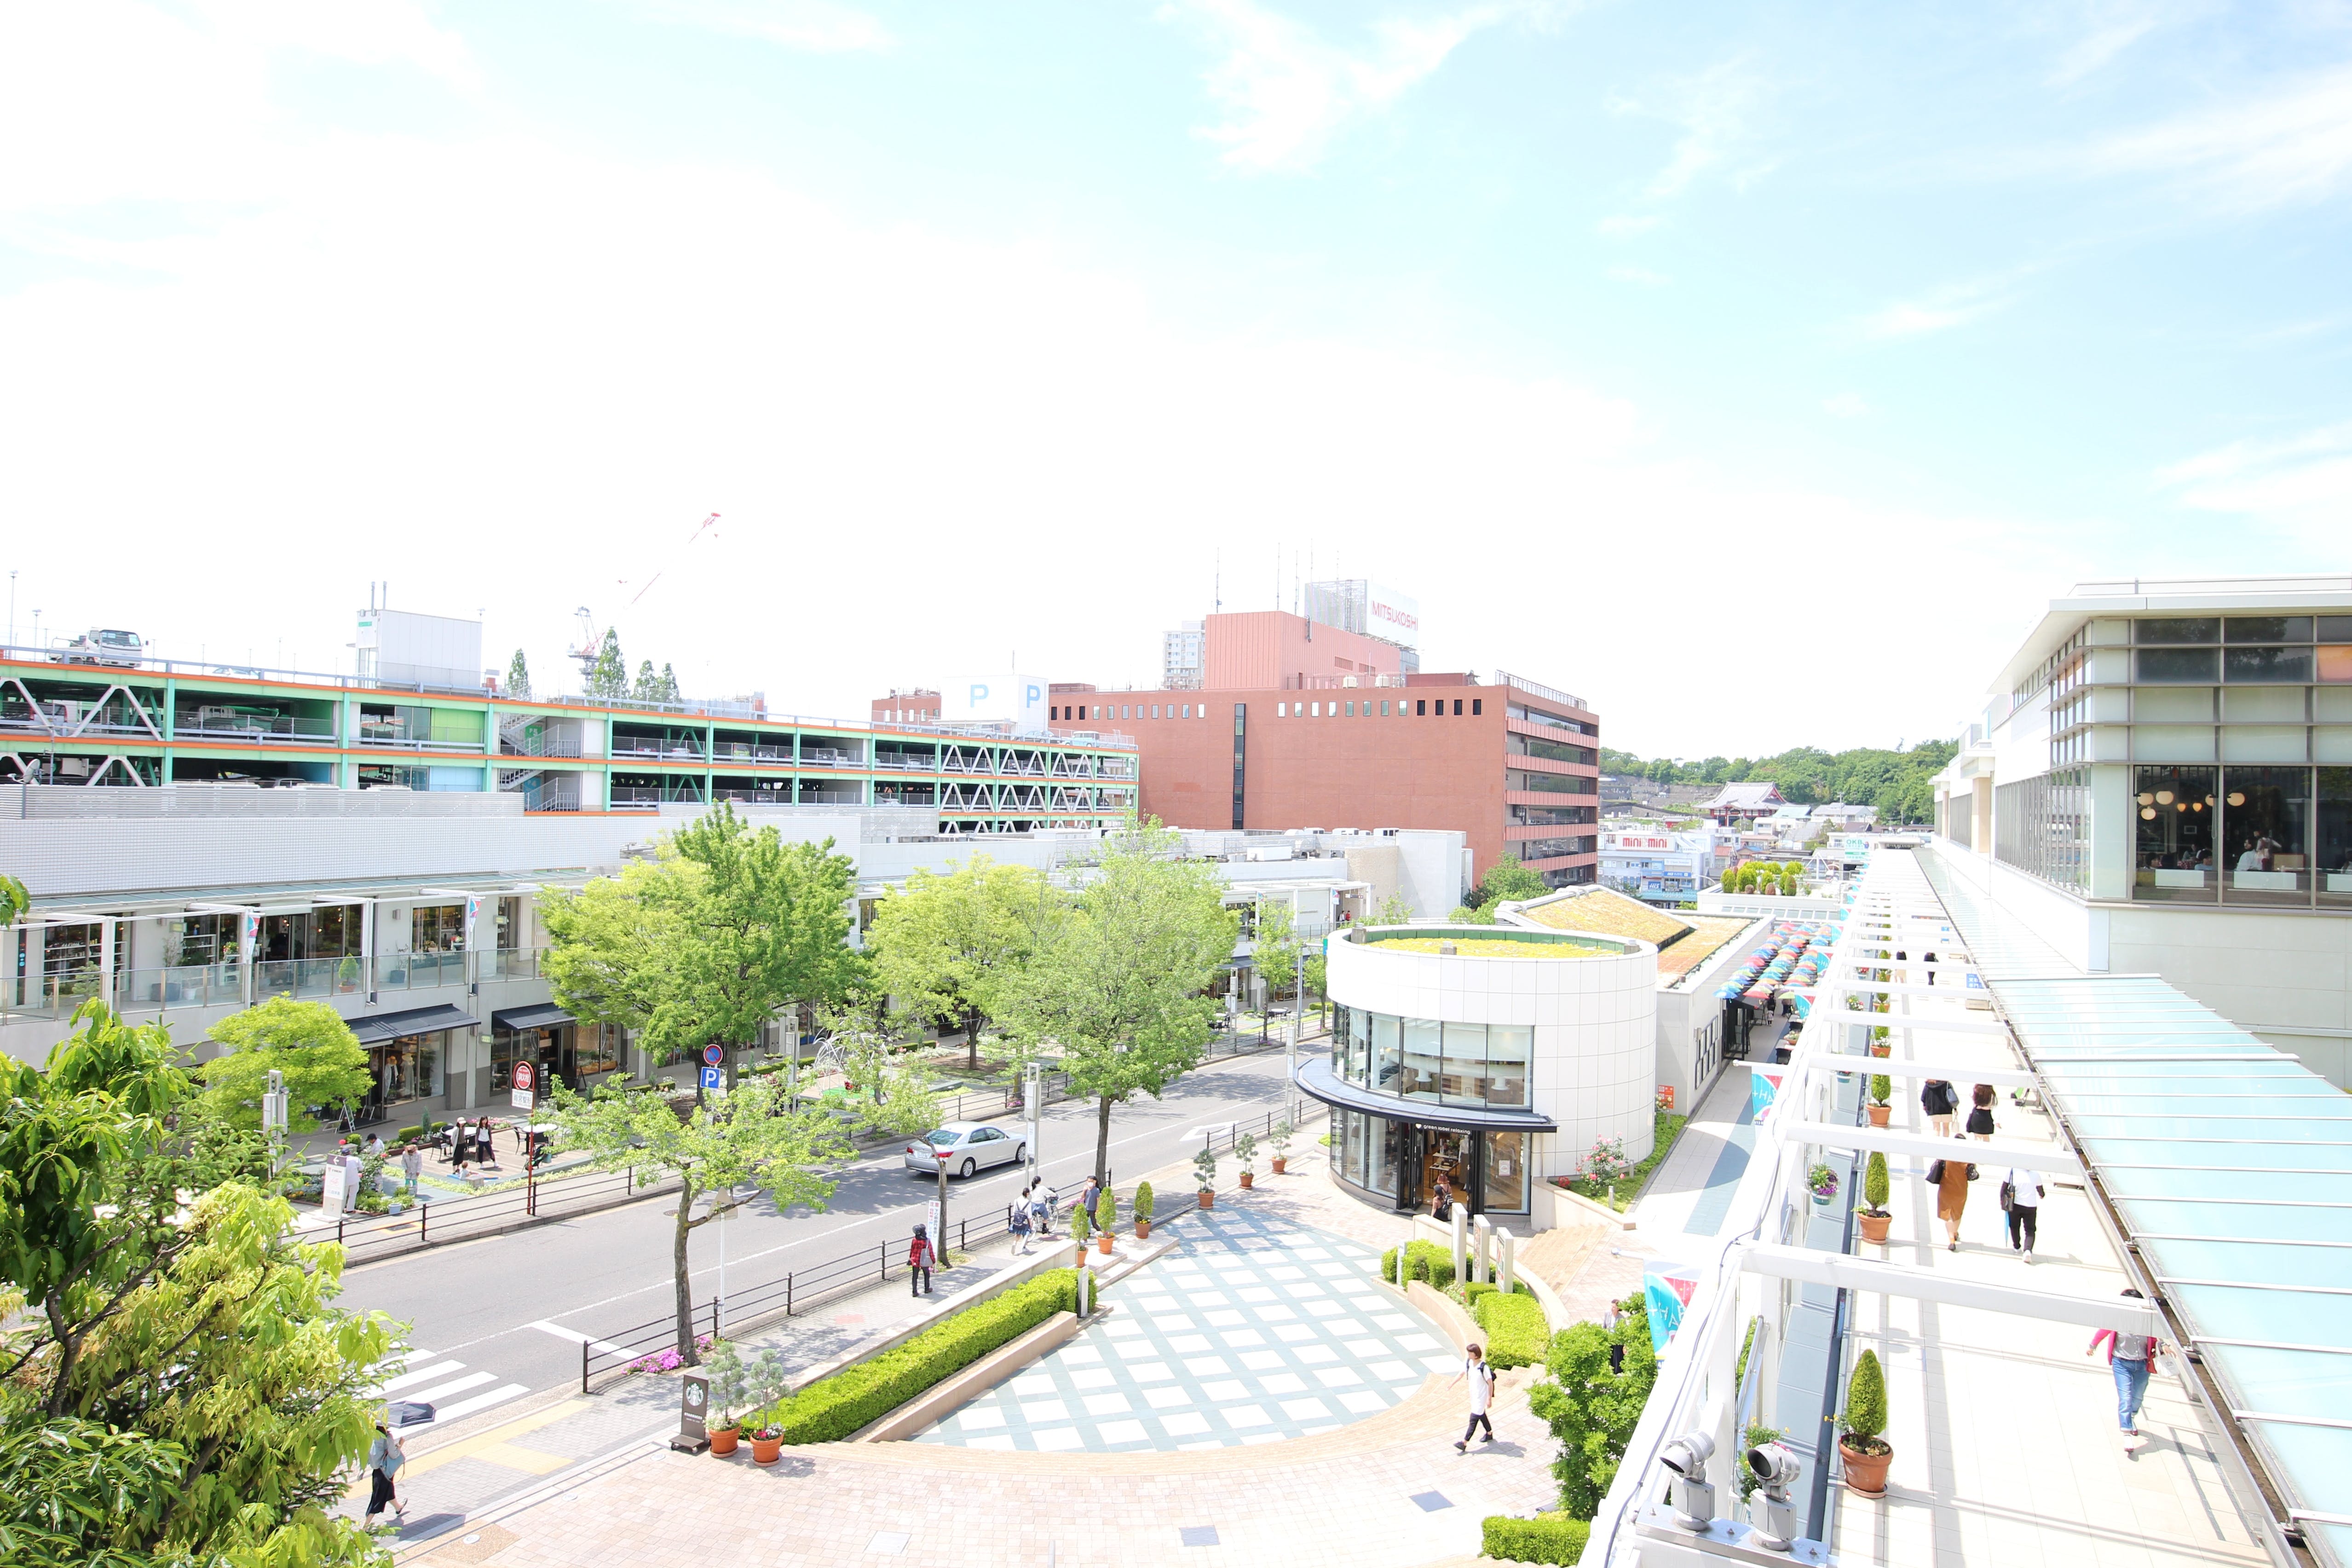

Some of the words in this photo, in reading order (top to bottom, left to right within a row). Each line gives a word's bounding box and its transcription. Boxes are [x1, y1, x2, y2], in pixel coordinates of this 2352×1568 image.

[1372, 600, 1418, 631] MITSUKOSHI
[970, 684, 989, 708] P
[1026, 684, 1040, 708] P
[1623, 837, 1642, 847] mini
[1648, 838, 1667, 847] mini
[705, 1069, 717, 1086] P
